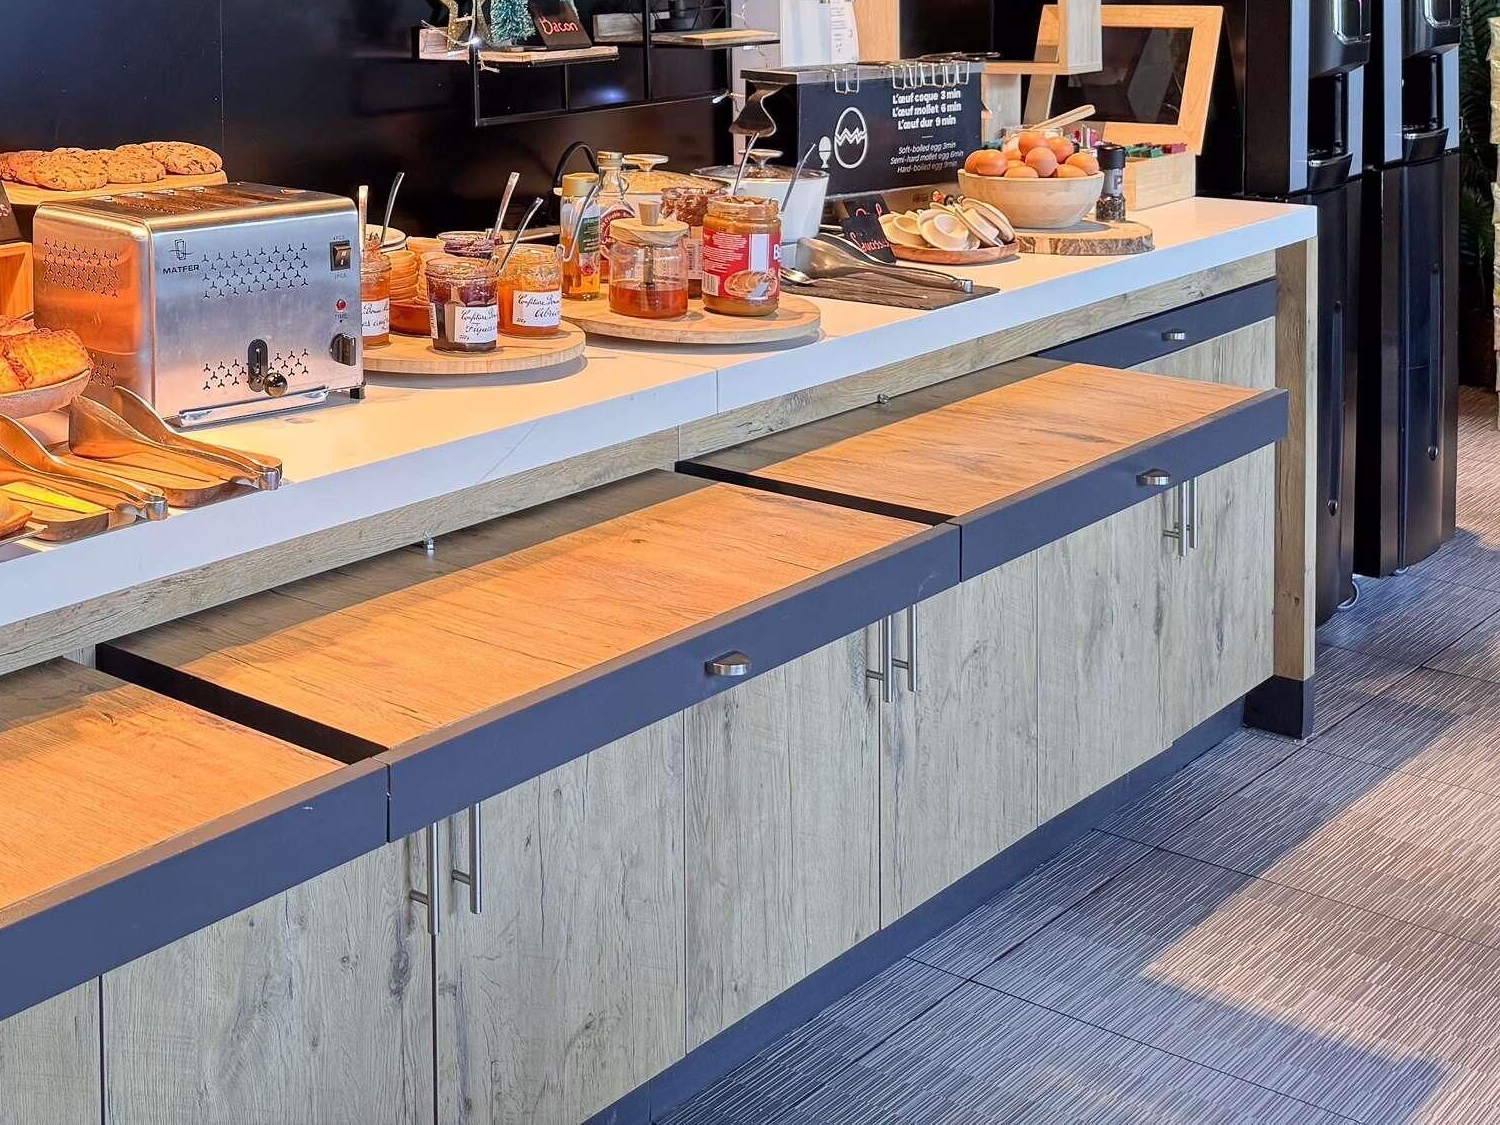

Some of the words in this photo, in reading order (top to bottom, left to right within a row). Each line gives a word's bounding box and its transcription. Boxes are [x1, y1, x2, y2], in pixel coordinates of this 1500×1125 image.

[538, 15, 579, 35] Bacon
[915, 92, 938, 103] coque
[941, 90, 946, 99] 3
[946, 88, 961, 99] min
[914, 104, 939, 115] mollet
[941, 104, 946, 113] 6
[947, 101, 962, 112] min
[920, 117, 933, 128] dur
[935, 117, 941, 126] 9
[942, 115, 956, 125] min
[930, 143, 941, 152] egg
[938, 152, 949, 160] egg
[931, 162, 942, 171] egg
[163, 264, 200, 275] MATFER
